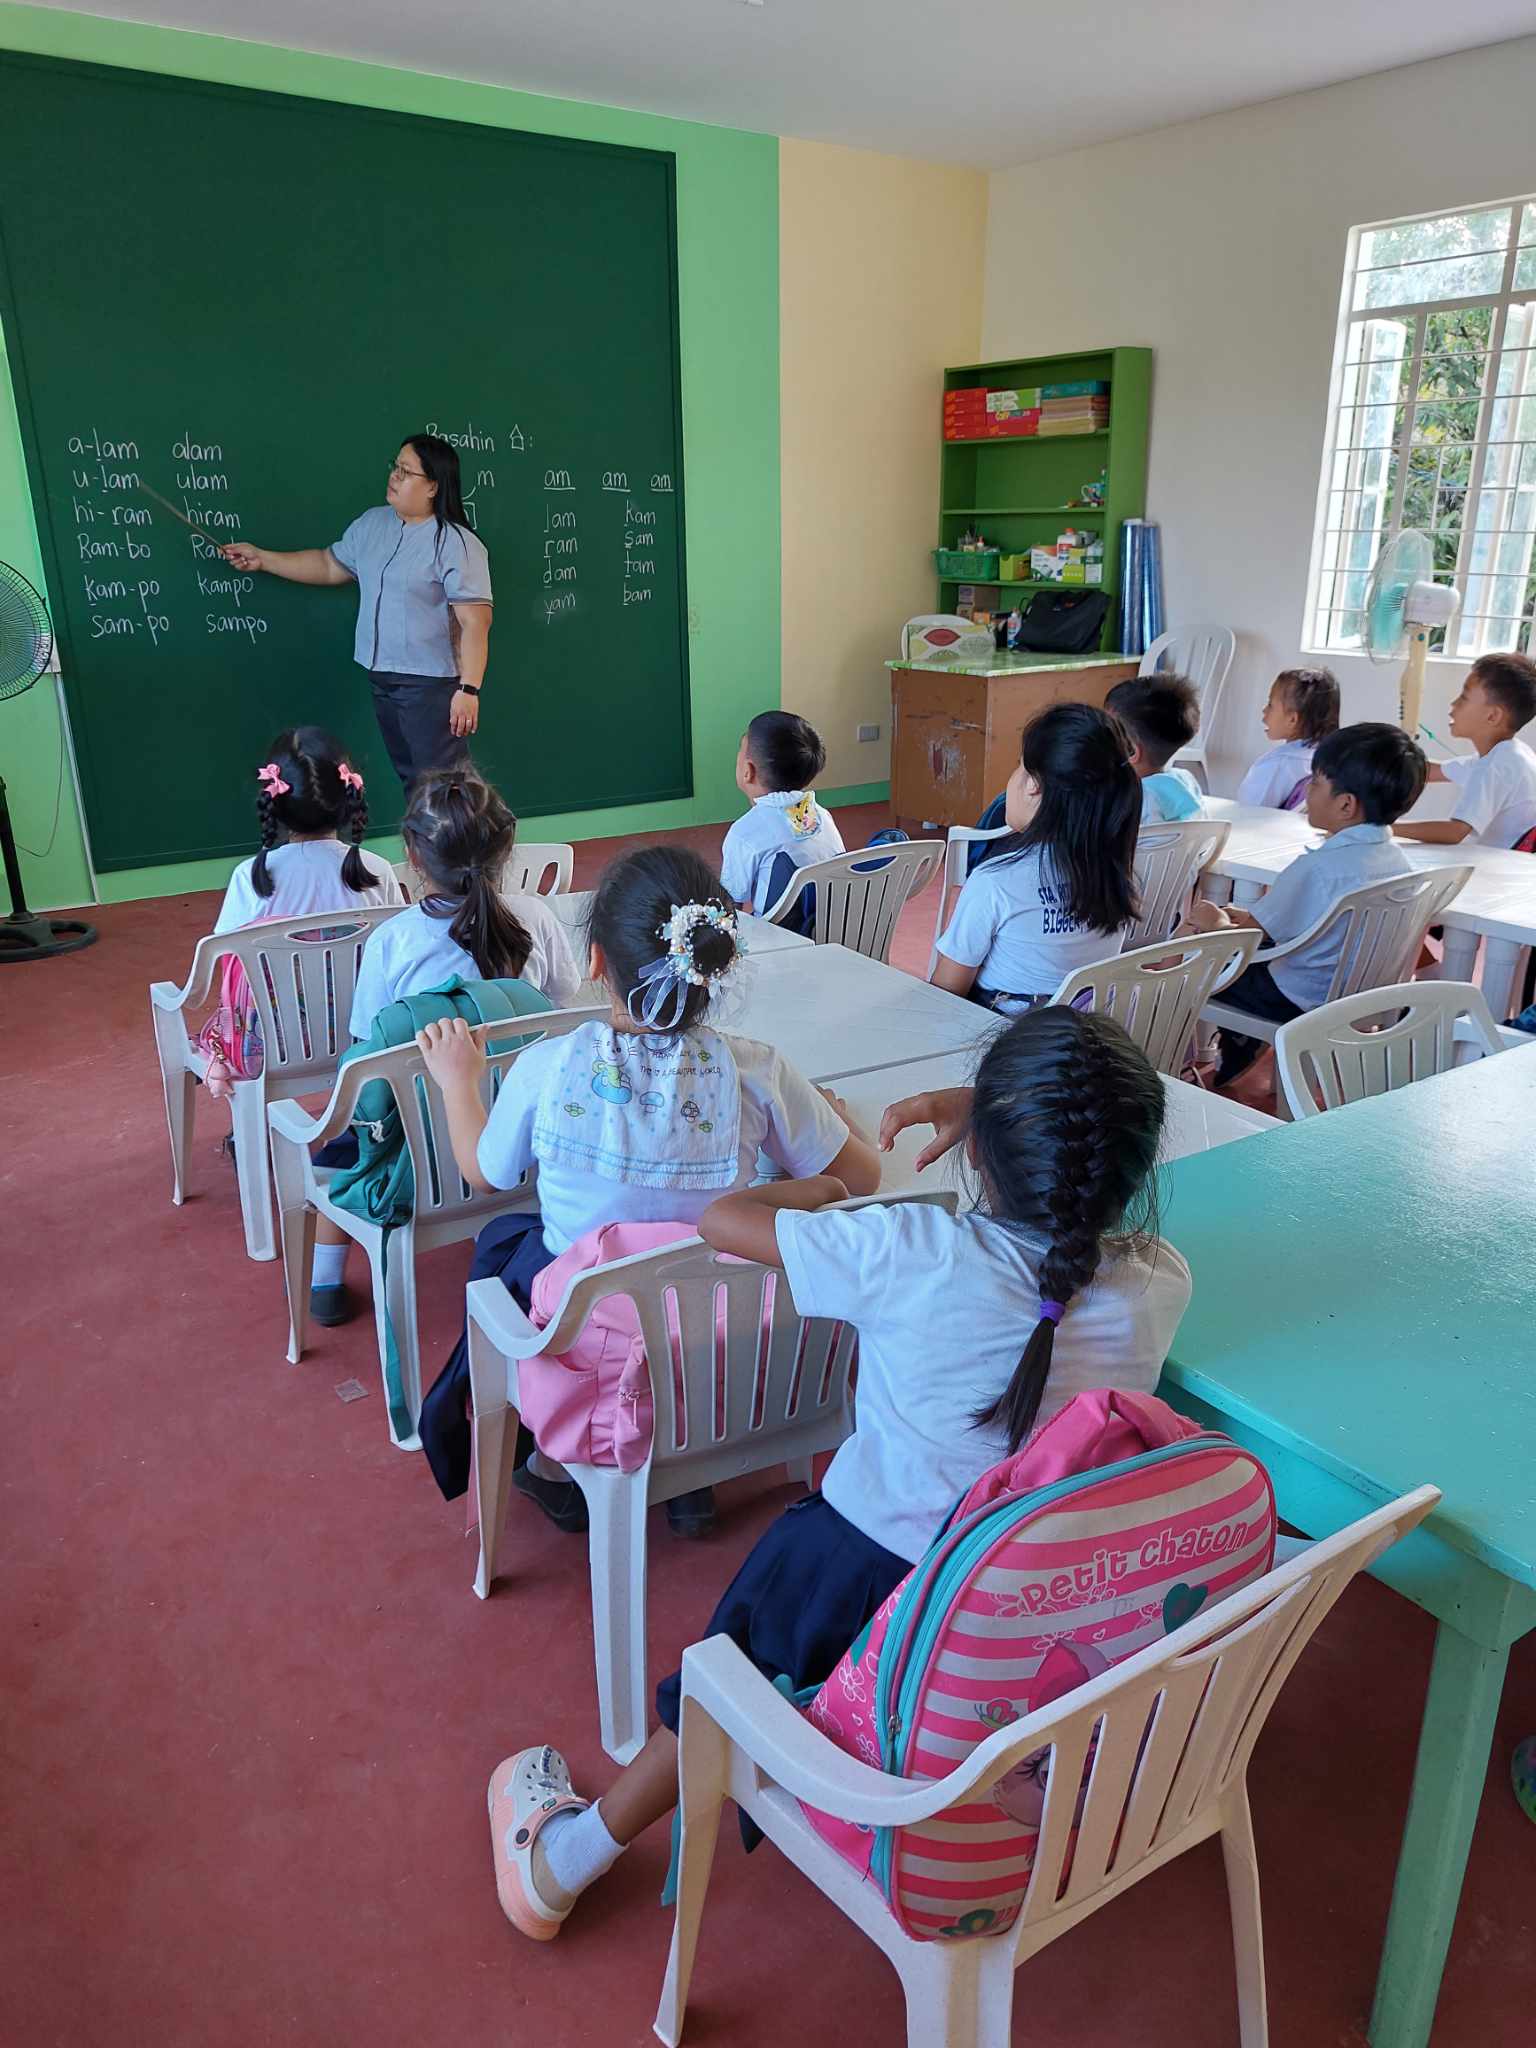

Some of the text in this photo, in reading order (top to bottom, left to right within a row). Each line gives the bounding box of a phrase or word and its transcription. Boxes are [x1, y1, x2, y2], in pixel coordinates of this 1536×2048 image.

[172, 431, 222, 461] alam
[176, 464, 228, 490] ulam
[544, 470, 671, 489] am am am
[183, 496, 241, 529] hiram
